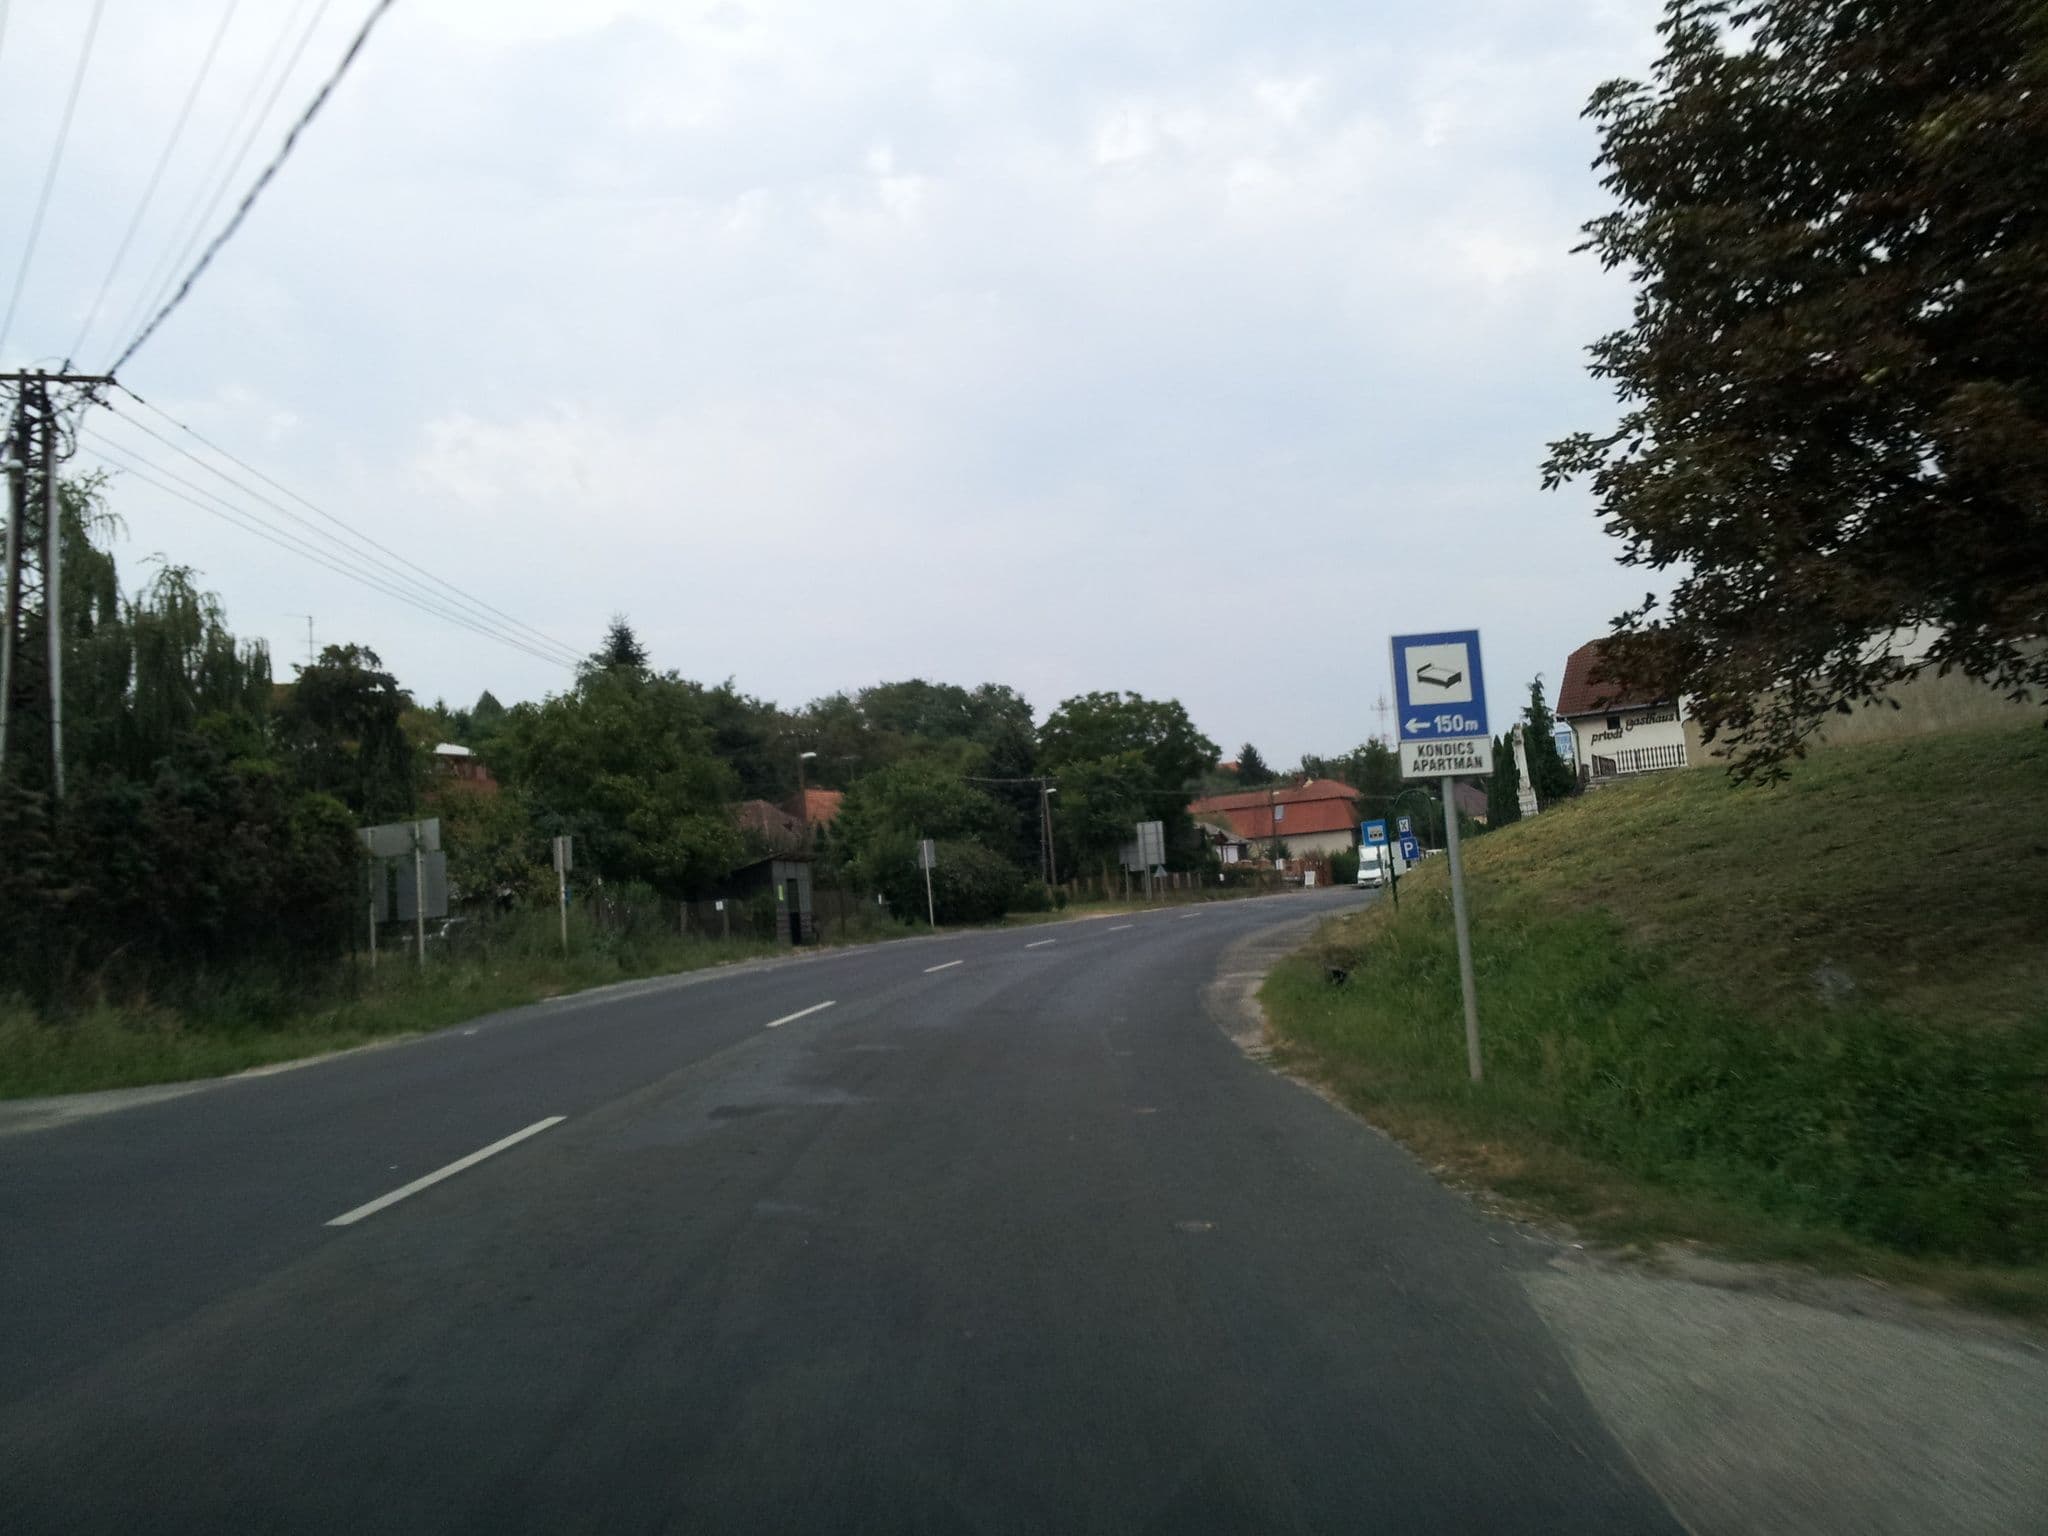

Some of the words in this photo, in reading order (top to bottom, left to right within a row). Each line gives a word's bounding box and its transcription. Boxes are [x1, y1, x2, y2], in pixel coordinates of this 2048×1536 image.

[1434, 714, 1479, 733] 150m
[1626, 712, 1674, 731] gasthaus
[1417, 742, 1475, 758] KONDICS
[1412, 758, 1484, 773] APARTMAN
